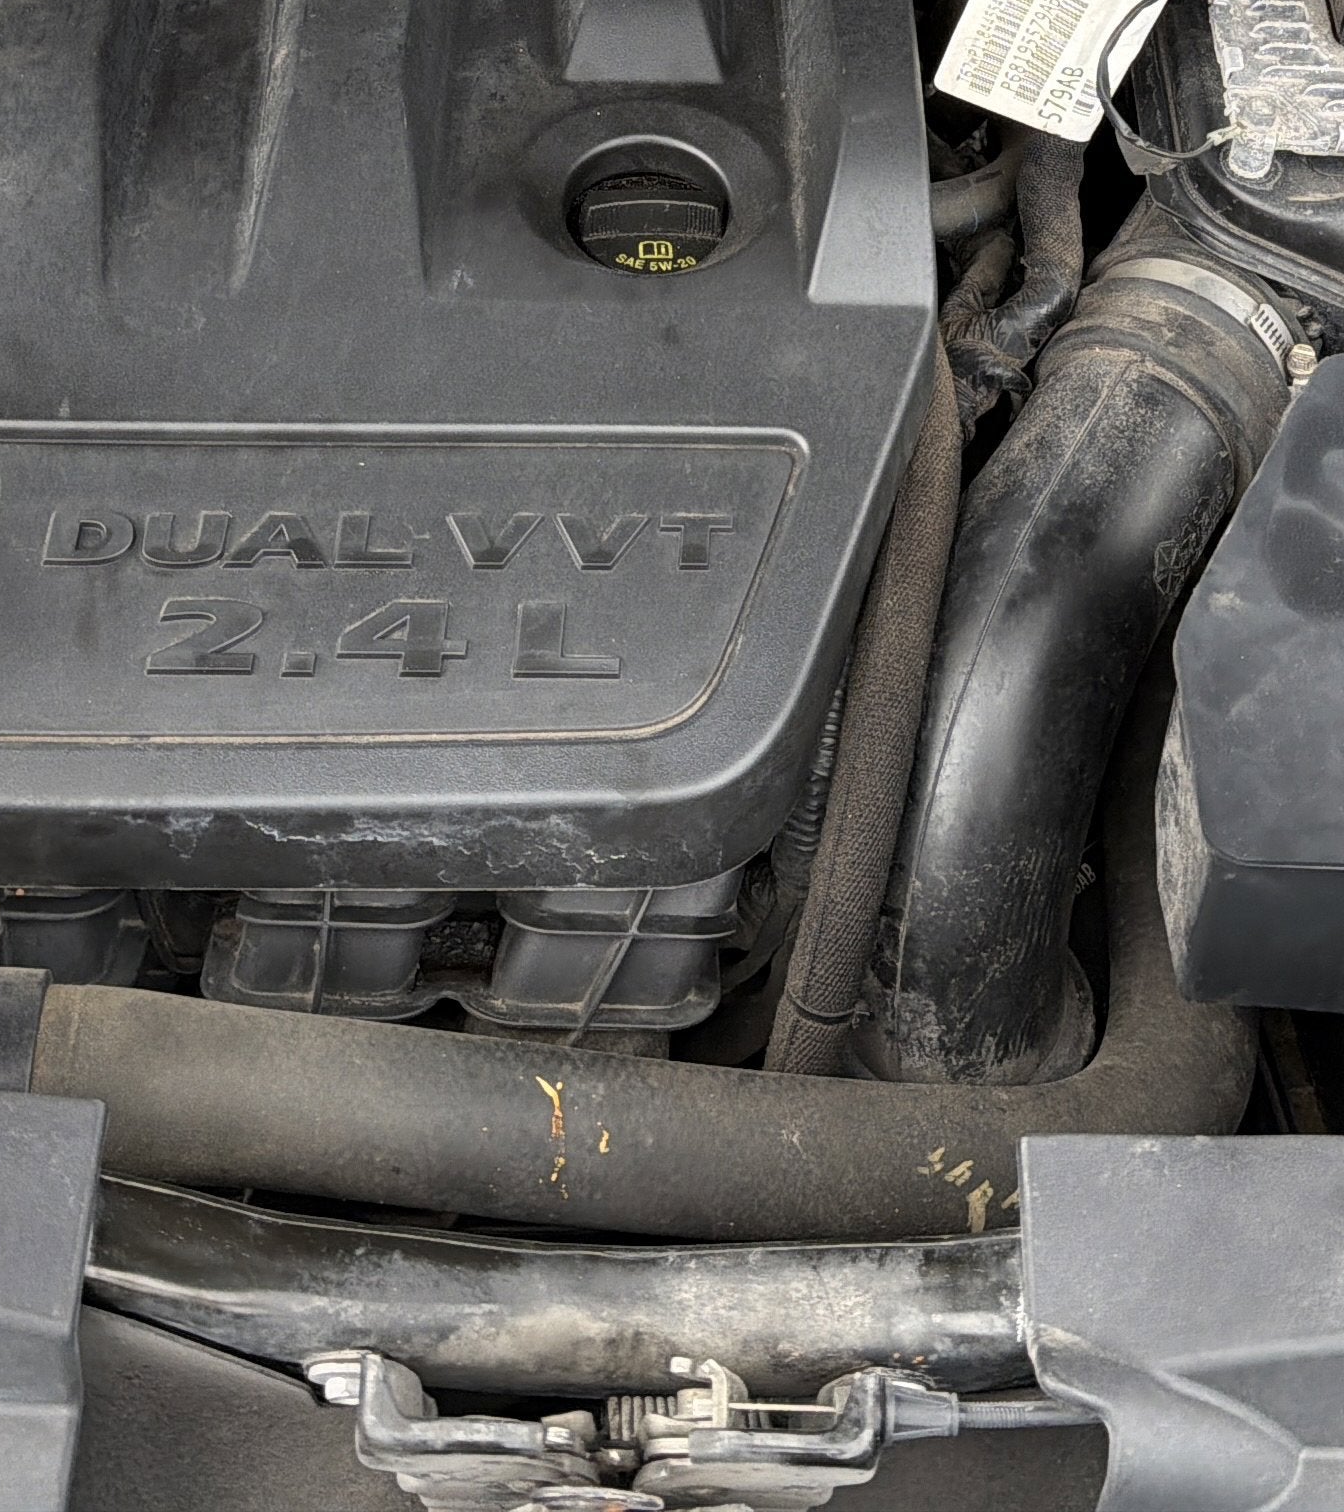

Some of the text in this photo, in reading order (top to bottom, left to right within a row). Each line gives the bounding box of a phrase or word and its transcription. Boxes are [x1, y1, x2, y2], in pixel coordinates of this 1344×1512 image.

[1037, 66, 1085, 124] 579AB
[615, 253, 697, 272] SAE 5W-20
[42, 510, 735, 572] DUAL VVT
